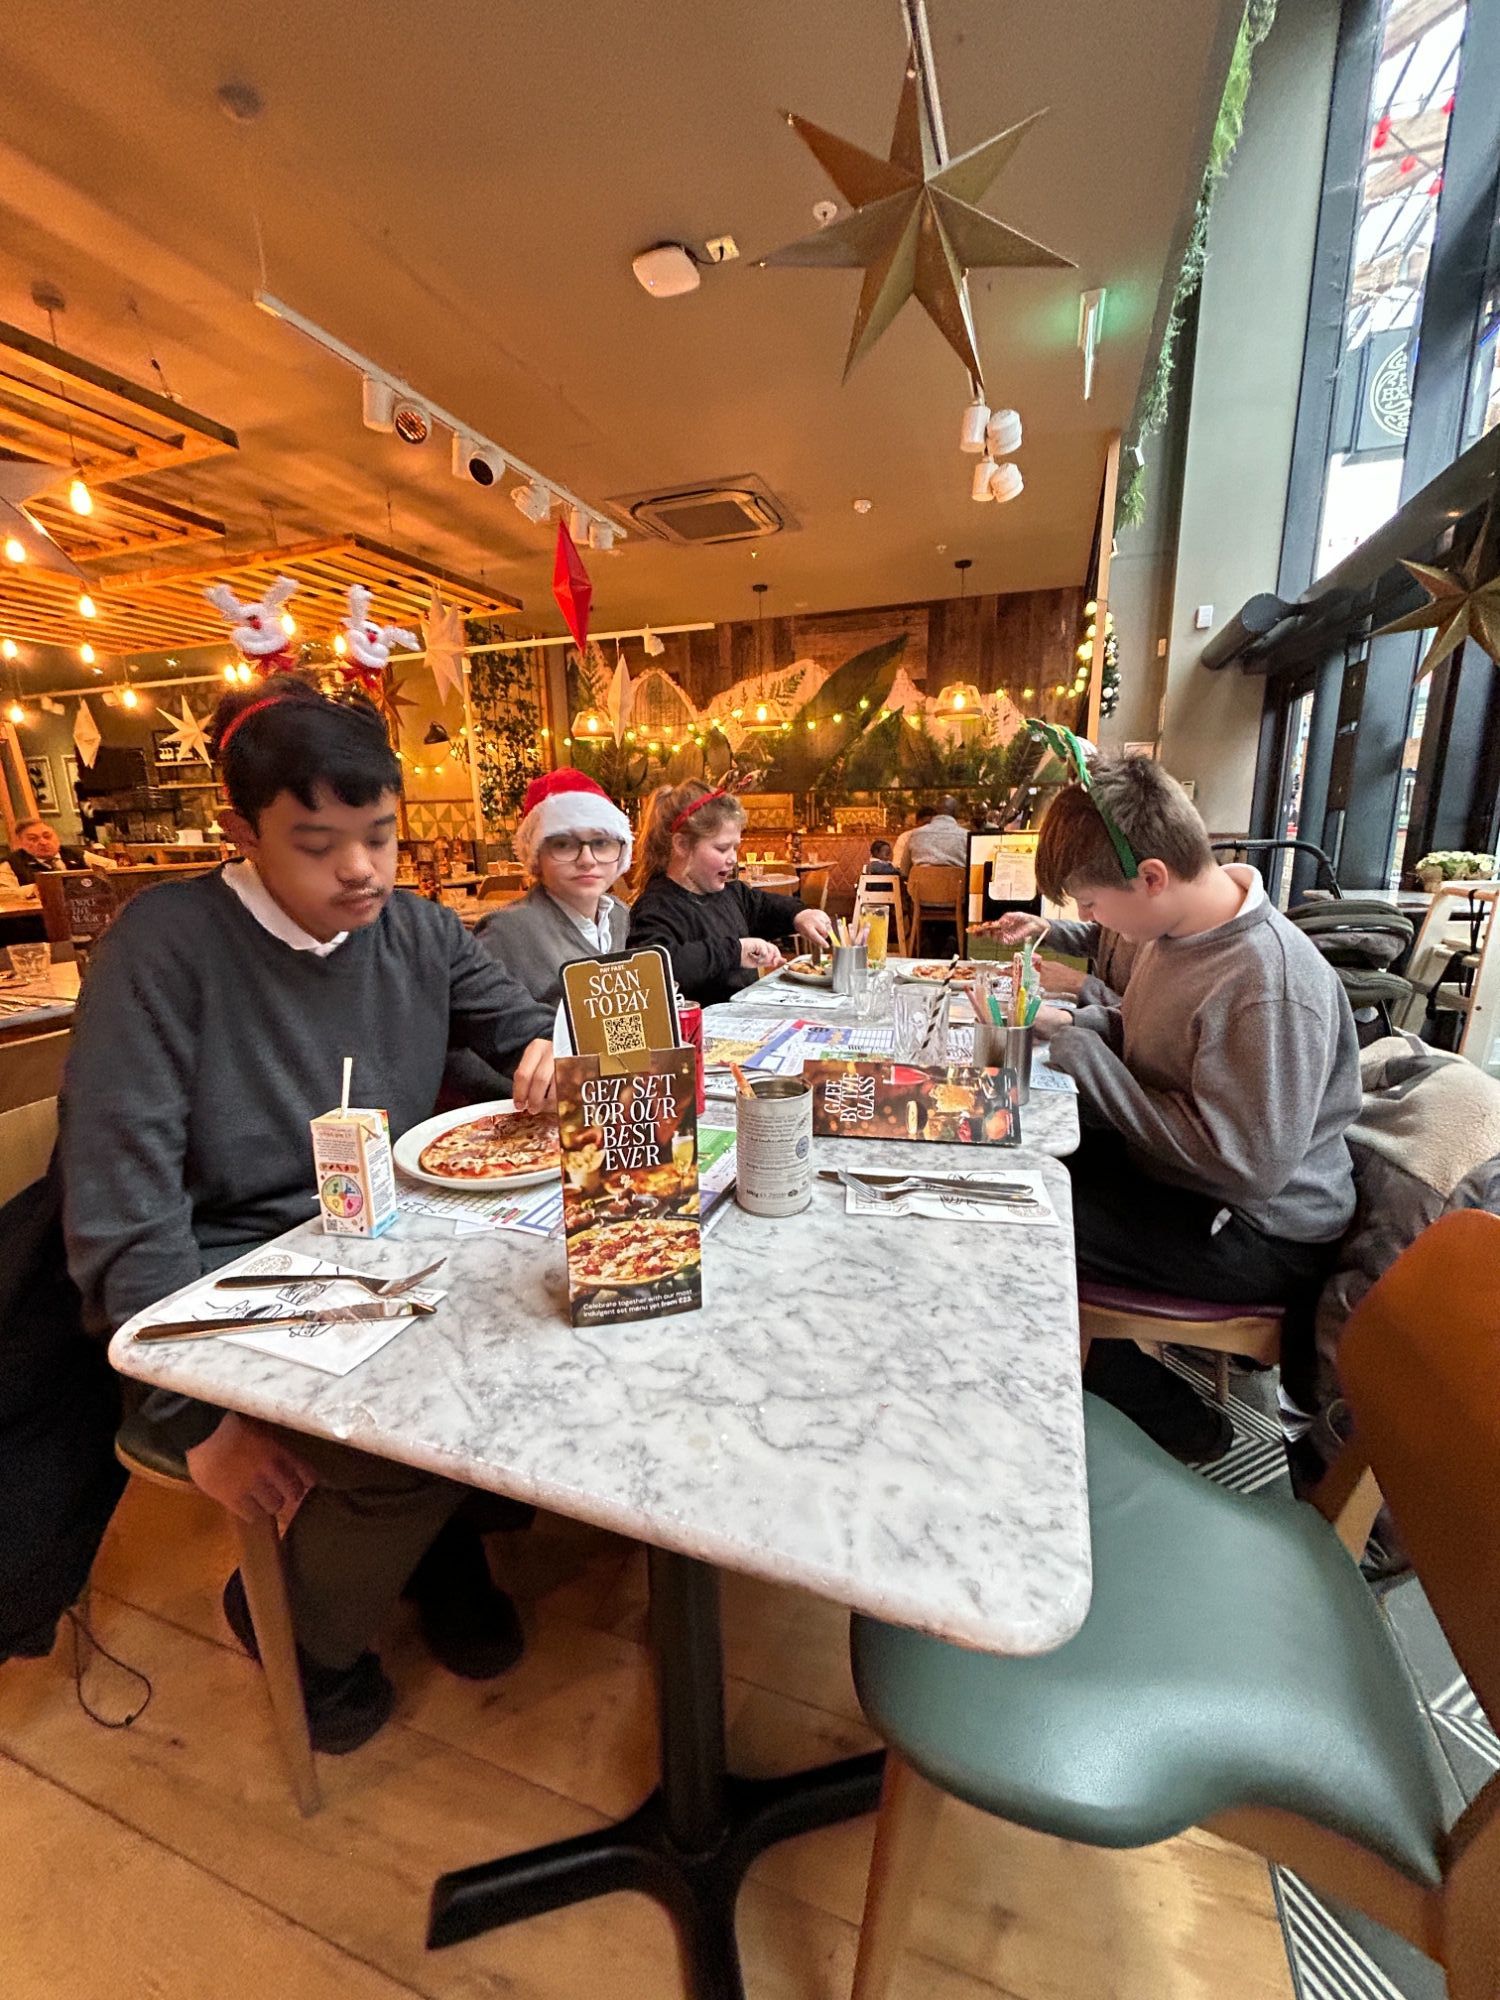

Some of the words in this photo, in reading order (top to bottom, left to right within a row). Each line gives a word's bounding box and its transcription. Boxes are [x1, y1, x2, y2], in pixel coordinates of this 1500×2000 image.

[589, 969, 641, 996] SCAN
[584, 996, 613, 1018] TO
[616, 989, 650, 1014] PAY
[581, 1078, 626, 1104] GET
[632, 1073, 676, 1100] SET
[823, 1079, 842, 1114] GLEE
[841, 1072, 860, 1102] THE
[856, 1076, 876, 1120] GLASS
[583, 1102, 627, 1127] FOR
[630, 1097, 678, 1122] OUR
[839, 1103, 858, 1122] BY
[603, 1122, 661, 1149] BEST
[605, 1144, 662, 1172] EVER
[583, 1301, 617, 1310] Celebrate
[618, 1297, 647, 1308] together
[648, 1294, 663, 1302] with
[663, 1292, 675, 1300] our
[676, 1289, 693, 1297] most
[629, 1304, 649, 1313] menu
[649, 1302, 660, 1311] yet
[660, 1299, 678, 1308] from
